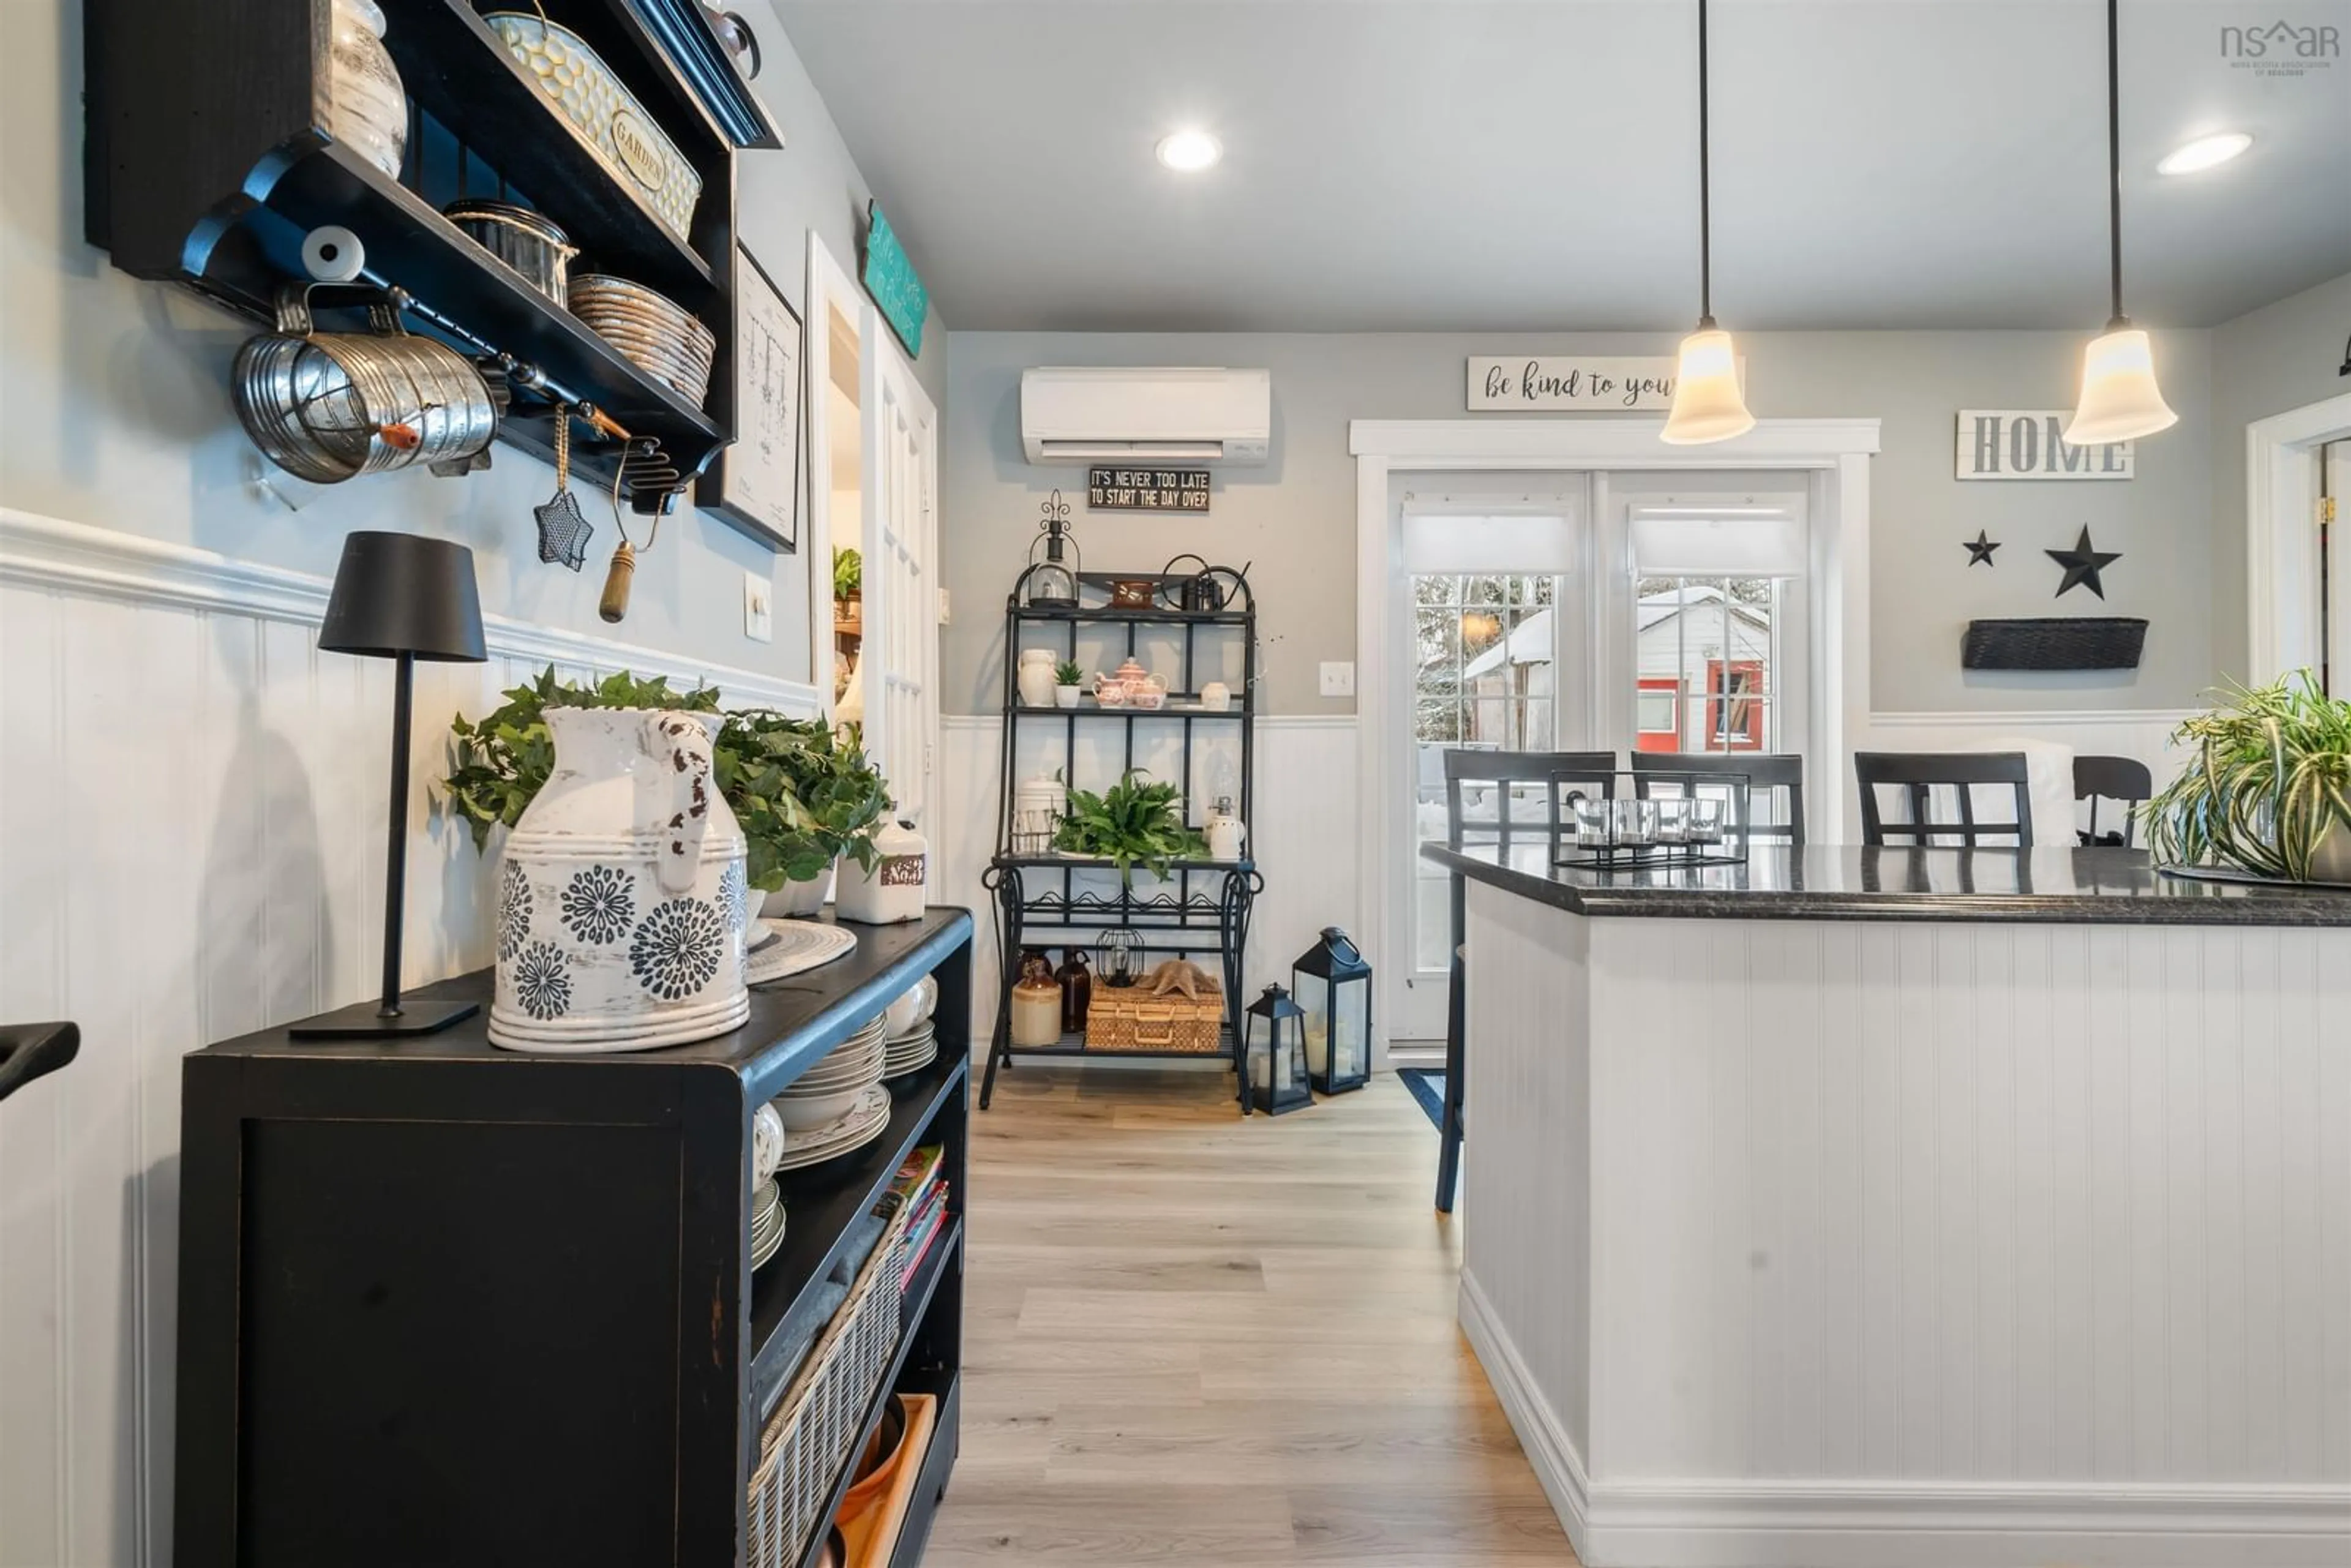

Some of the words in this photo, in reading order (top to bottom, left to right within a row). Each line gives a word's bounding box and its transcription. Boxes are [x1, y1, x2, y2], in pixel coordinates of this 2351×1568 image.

[617, 122, 662, 181] GARDEN
[1485, 366, 1512, 399] be
[1522, 361, 1582, 400] kind
[1588, 372, 1617, 397] to
[1091, 470, 1111, 486] IT'S
[1115, 471, 1151, 487] NEVER
[1156, 473, 1177, 488] TOO
[1181, 473, 1208, 489] LATE
[1091, 488, 1103, 504] TO
[1106, 489, 1137, 505] START
[1140, 490, 1157, 506] THE
[1161, 490, 1180, 506] DAY
[1182, 492, 1207, 507] OVER
